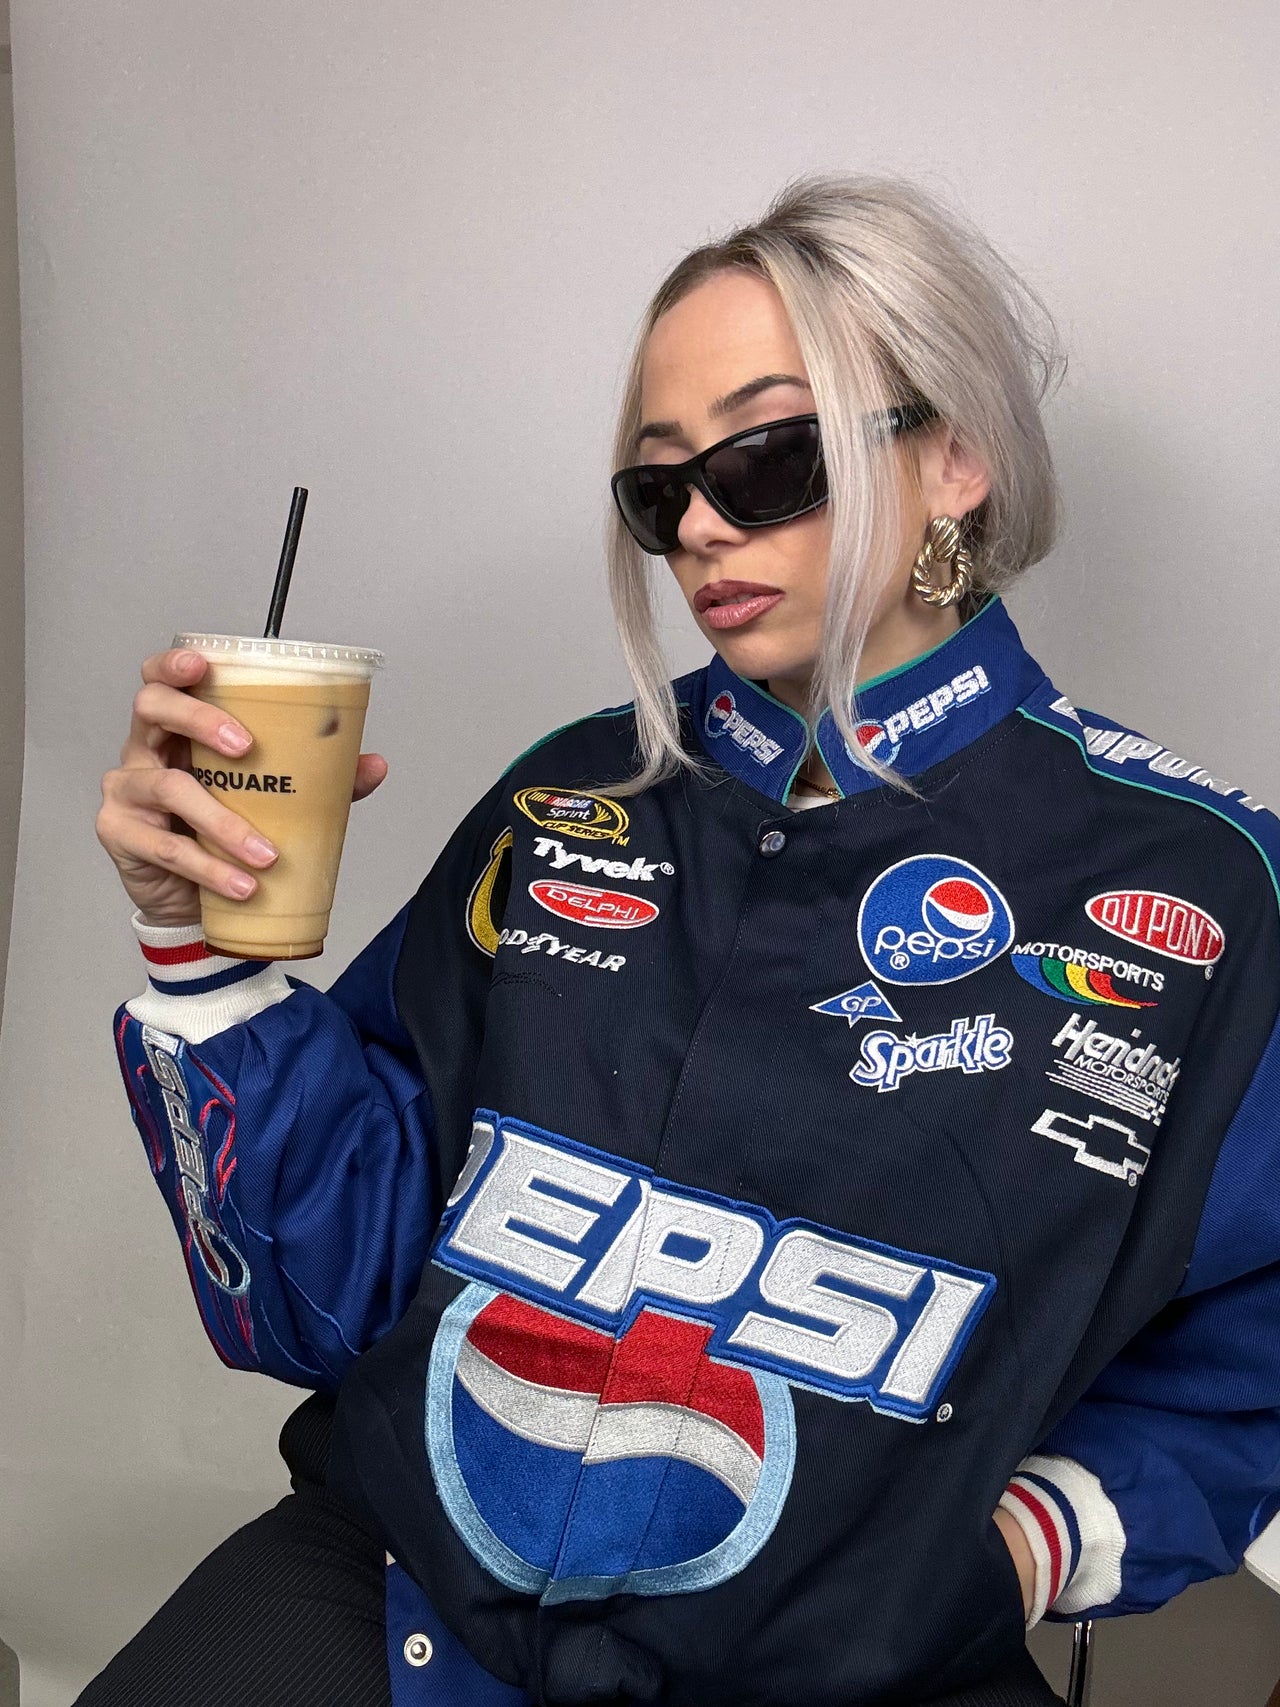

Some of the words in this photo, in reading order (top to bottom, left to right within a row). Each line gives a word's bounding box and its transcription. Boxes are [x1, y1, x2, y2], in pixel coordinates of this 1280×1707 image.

[883, 665, 989, 744] PEPSI
[721, 711, 784, 766] PEPSI
[544, 821, 567, 830] CUP
[568, 825, 610, 839] SERIES
[546, 807, 591, 820] Sprint
[546, 886, 641, 920] DELPHI
[874, 925, 996, 963] pepsi
[1011, 942, 1165, 992] MOTORSPORTS
[841, 996, 882, 1013] GP
[849, 1013, 1015, 1093] Sparkle
[1073, 1055, 1170, 1104] MOTORSPORTS
